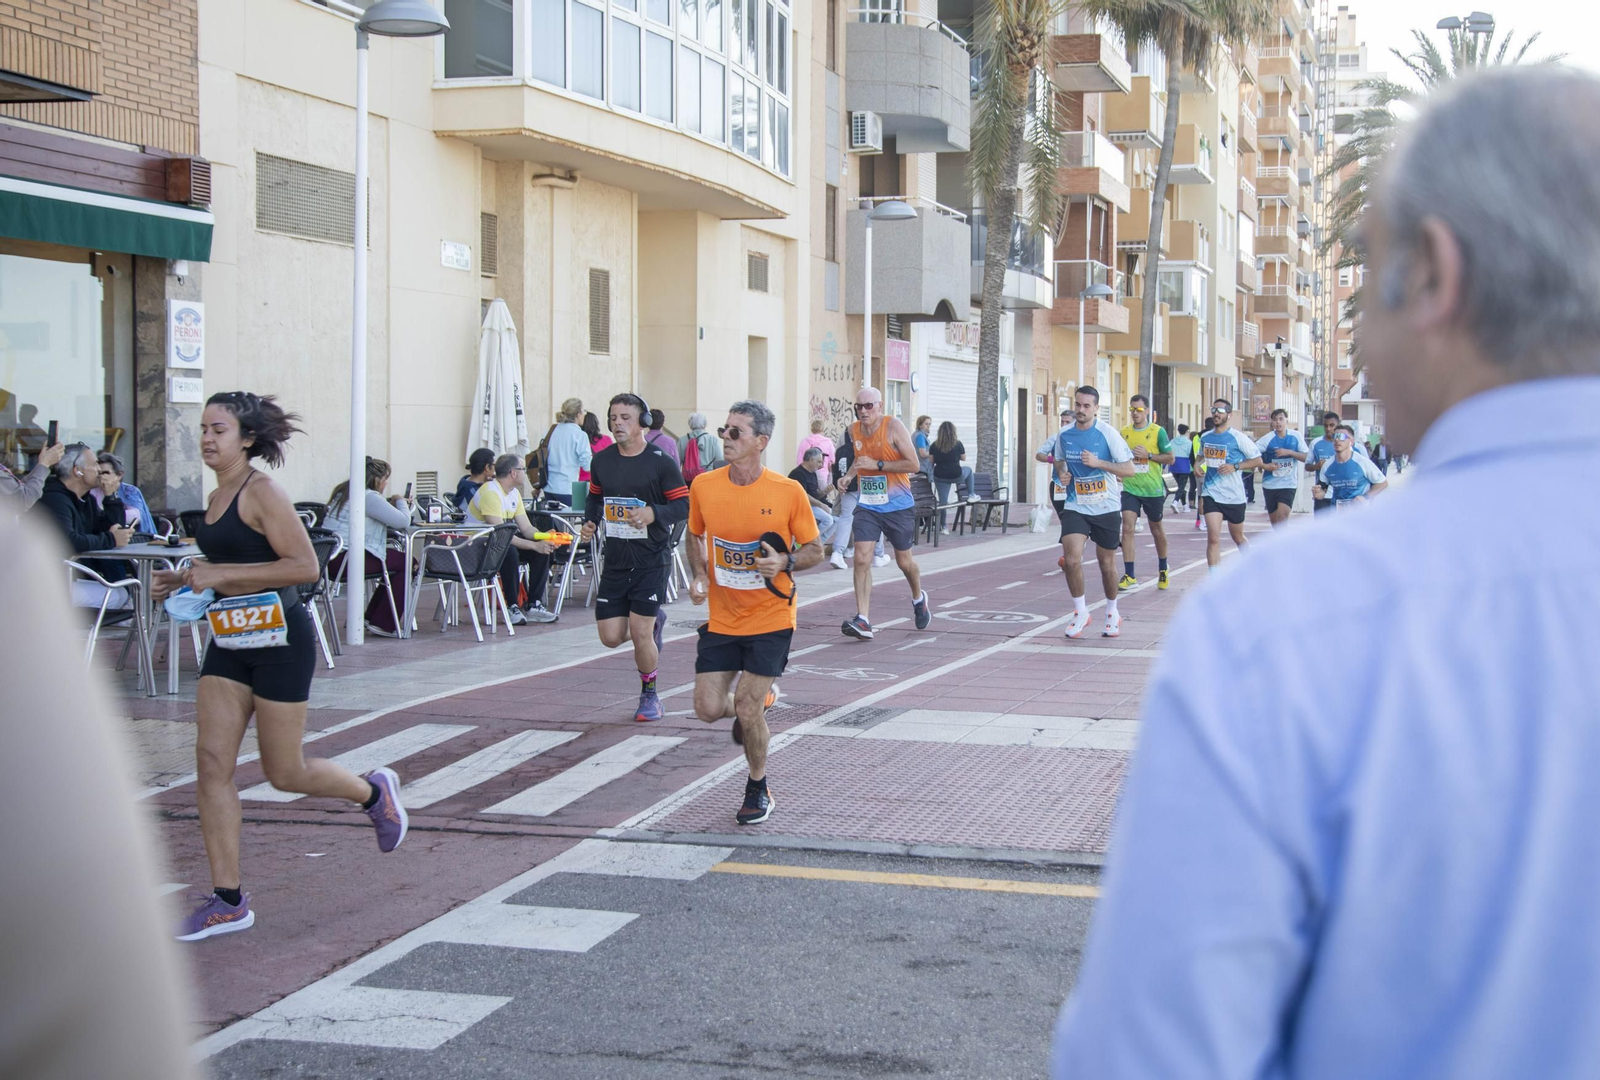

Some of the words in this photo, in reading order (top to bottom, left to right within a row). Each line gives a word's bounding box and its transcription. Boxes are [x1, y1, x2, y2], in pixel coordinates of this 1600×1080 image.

[174, 325, 202, 338] PERONI
[174, 381, 203, 393] PERONI
[1206, 448, 1224, 456] 1077
[862, 481, 885, 491] 2050
[1078, 480, 1104, 492] 1910
[724, 550, 756, 566] 695
[217, 604, 276, 630] 1827
